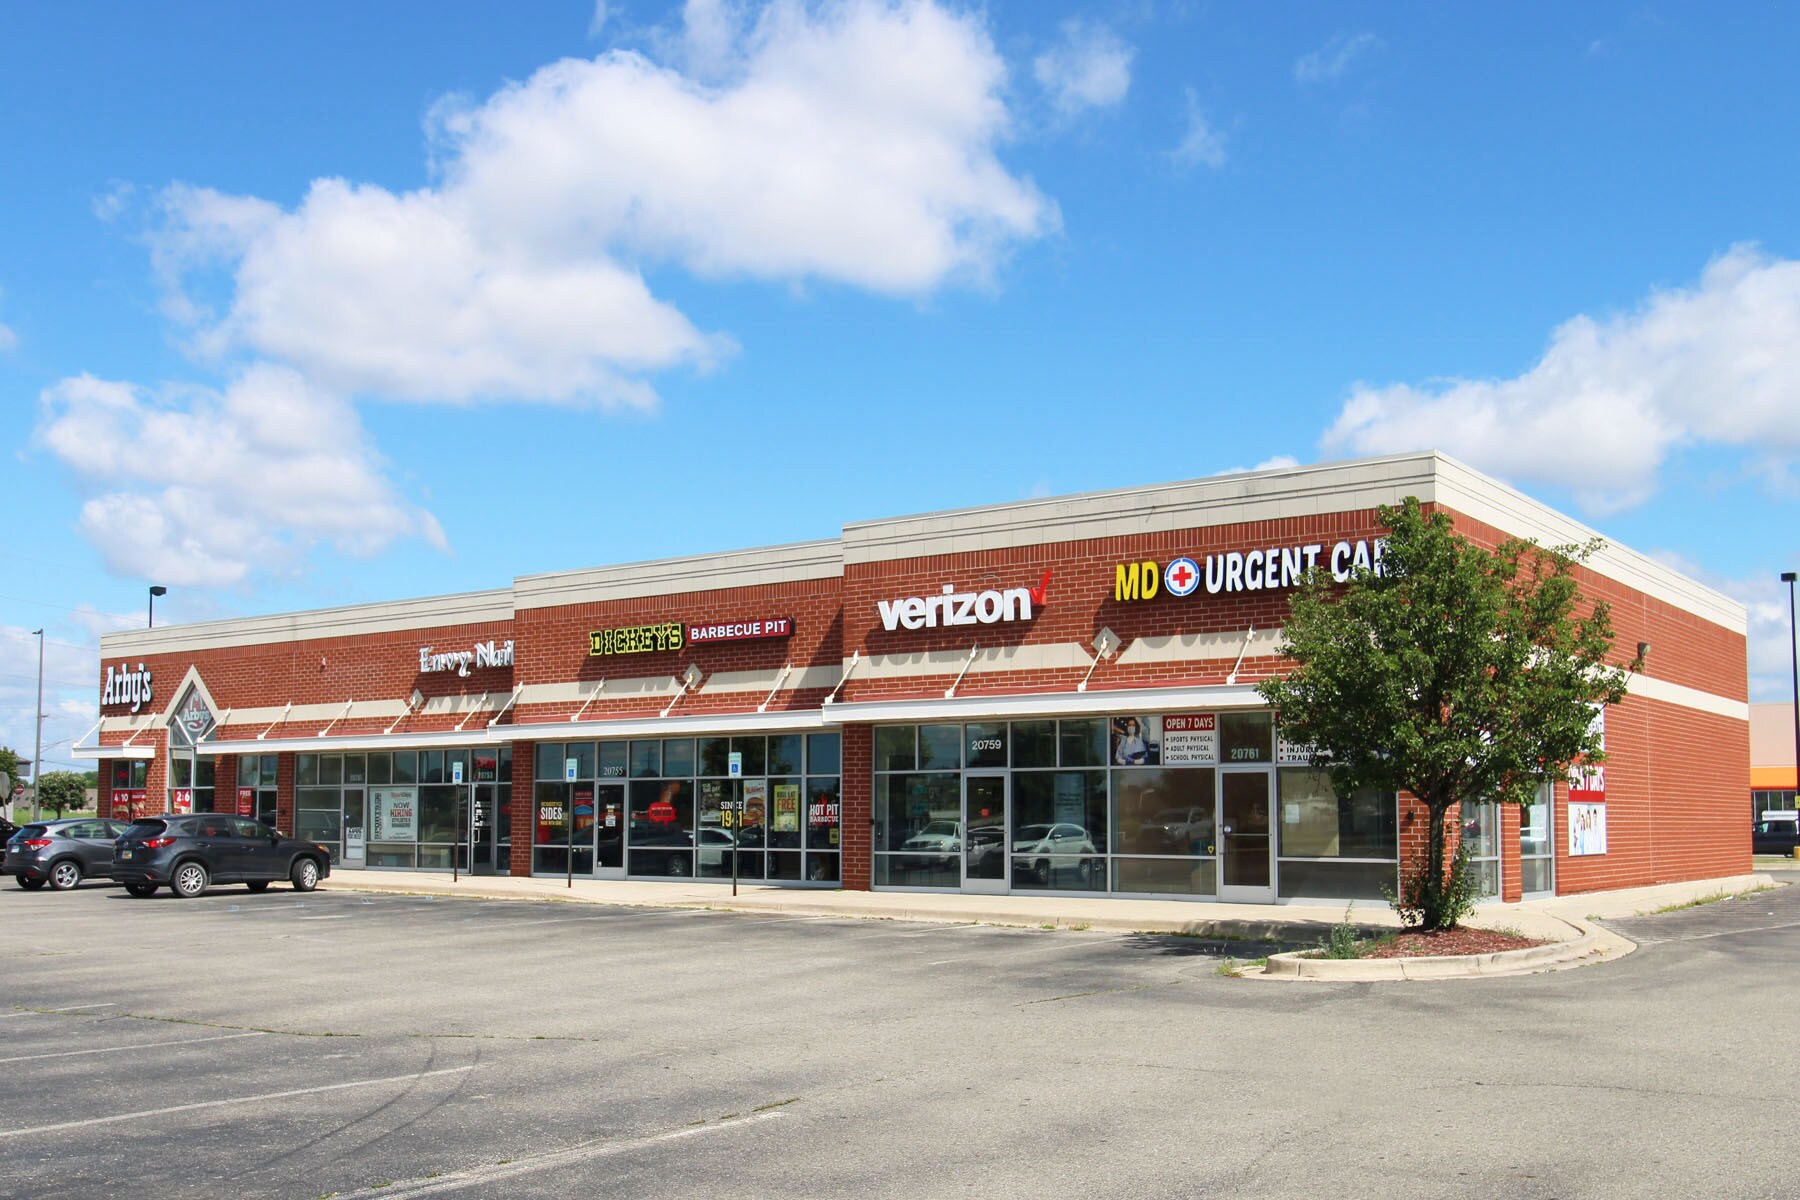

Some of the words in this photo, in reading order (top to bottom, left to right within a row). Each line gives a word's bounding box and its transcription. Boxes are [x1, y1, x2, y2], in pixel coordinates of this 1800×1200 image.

[1115, 561, 1159, 601] MD
[1206, 544, 1321, 594] URGENT
[877, 583, 1032, 631] verizon
[589, 622, 684, 656] DICKEY'S
[691, 622, 762, 640] BARBECUE
[765, 620, 787, 633] PIT
[419, 646, 473, 677] Envy
[102, 663, 152, 713] Arby's
[183, 708, 209, 722] Arby's
[1166, 718, 1185, 729] OPEN
[1187, 718, 1193, 729] 7
[1194, 717, 1214, 729] DAYS
[972, 739, 1002, 750] 20759
[1170, 735, 1189, 743] SPORTS
[1231, 748, 1260, 760] 20761
[604, 766, 623, 776] 20755
[121, 793, 129, 802] 10
[177, 791, 182, 802] 2
[184, 791, 190, 802] 6
[393, 801, 410, 809] NOW
[777, 798, 796, 810] FREE
[810, 804, 824, 816] HOT
[826, 804, 839, 816] PIT
[390, 808, 413, 817] HIRING
[541, 807, 563, 820] SIDES
